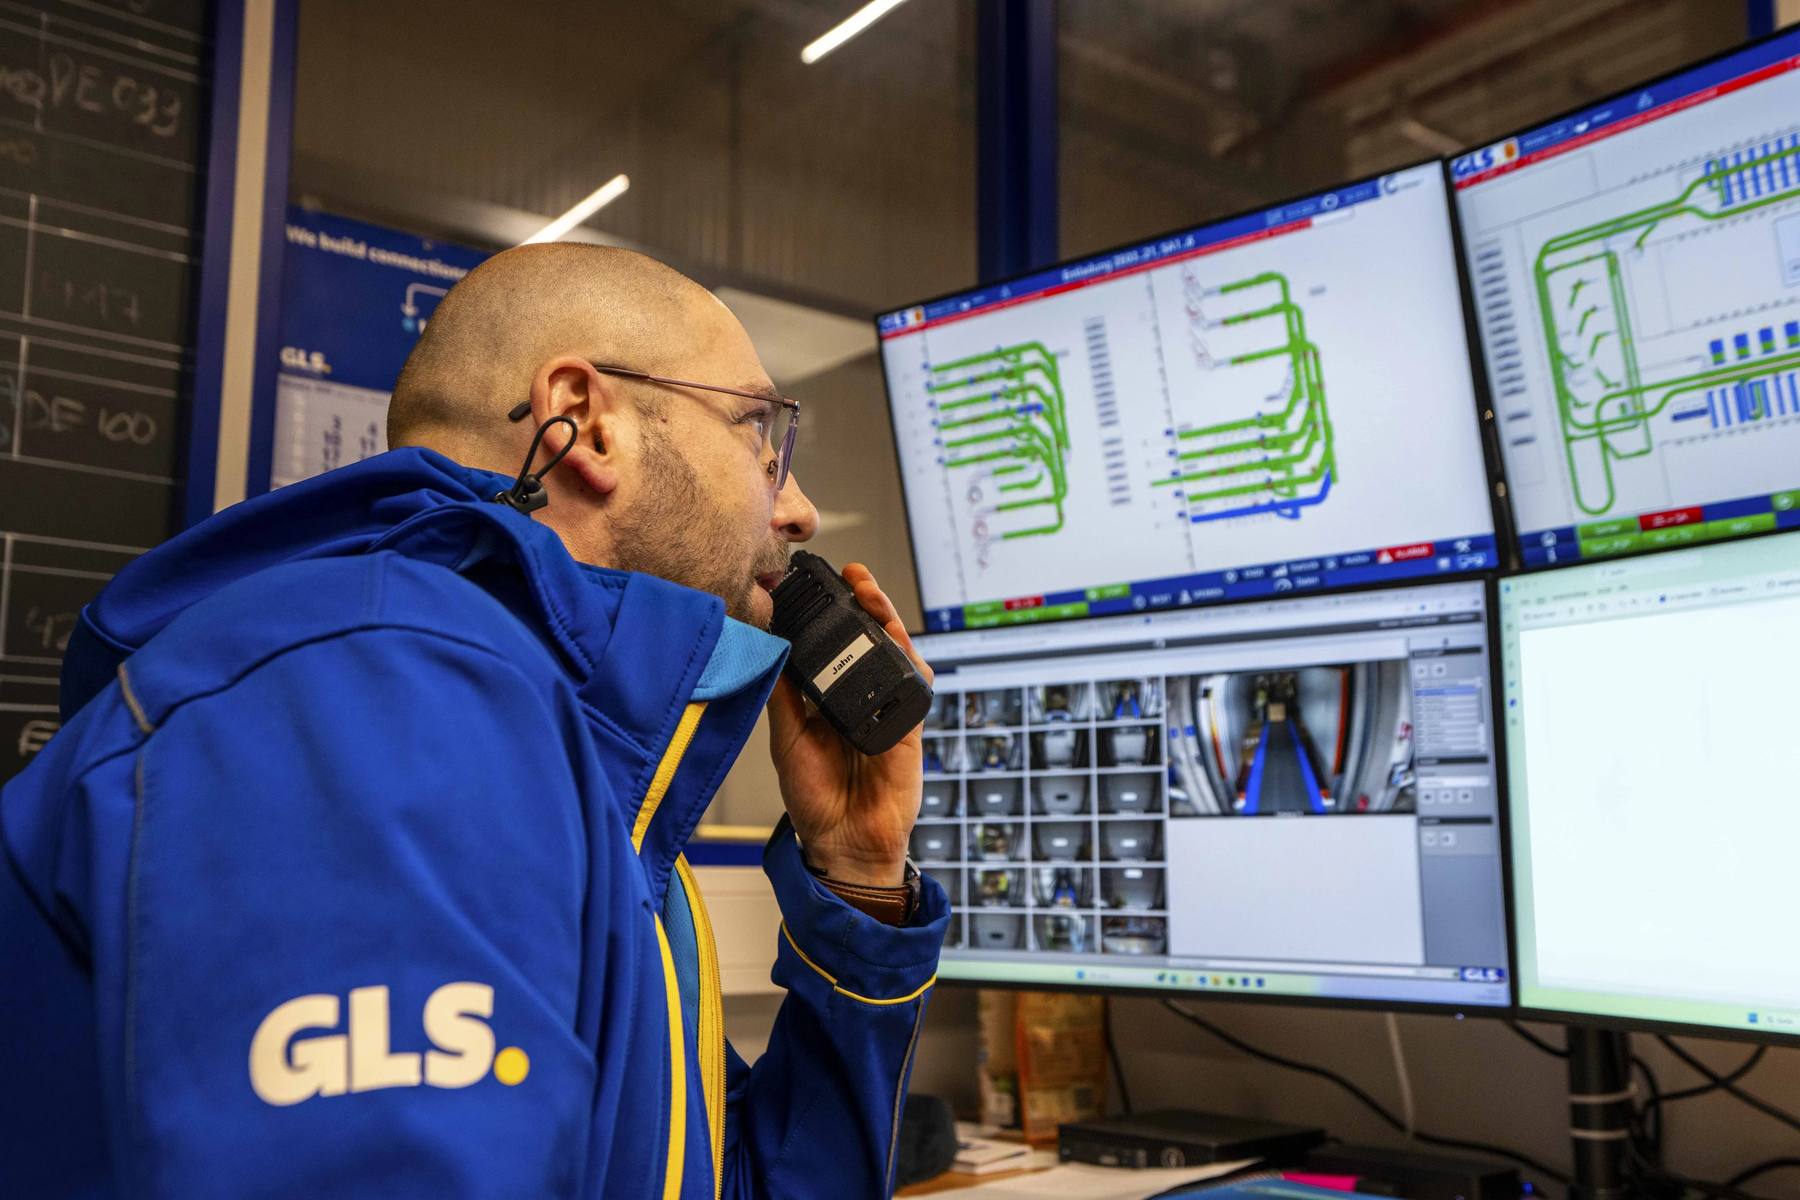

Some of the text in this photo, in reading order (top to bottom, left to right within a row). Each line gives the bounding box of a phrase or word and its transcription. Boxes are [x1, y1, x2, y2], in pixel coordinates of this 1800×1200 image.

[285, 225, 317, 248] We
[318, 231, 367, 260] build
[833, 654, 854, 675] Jahn
